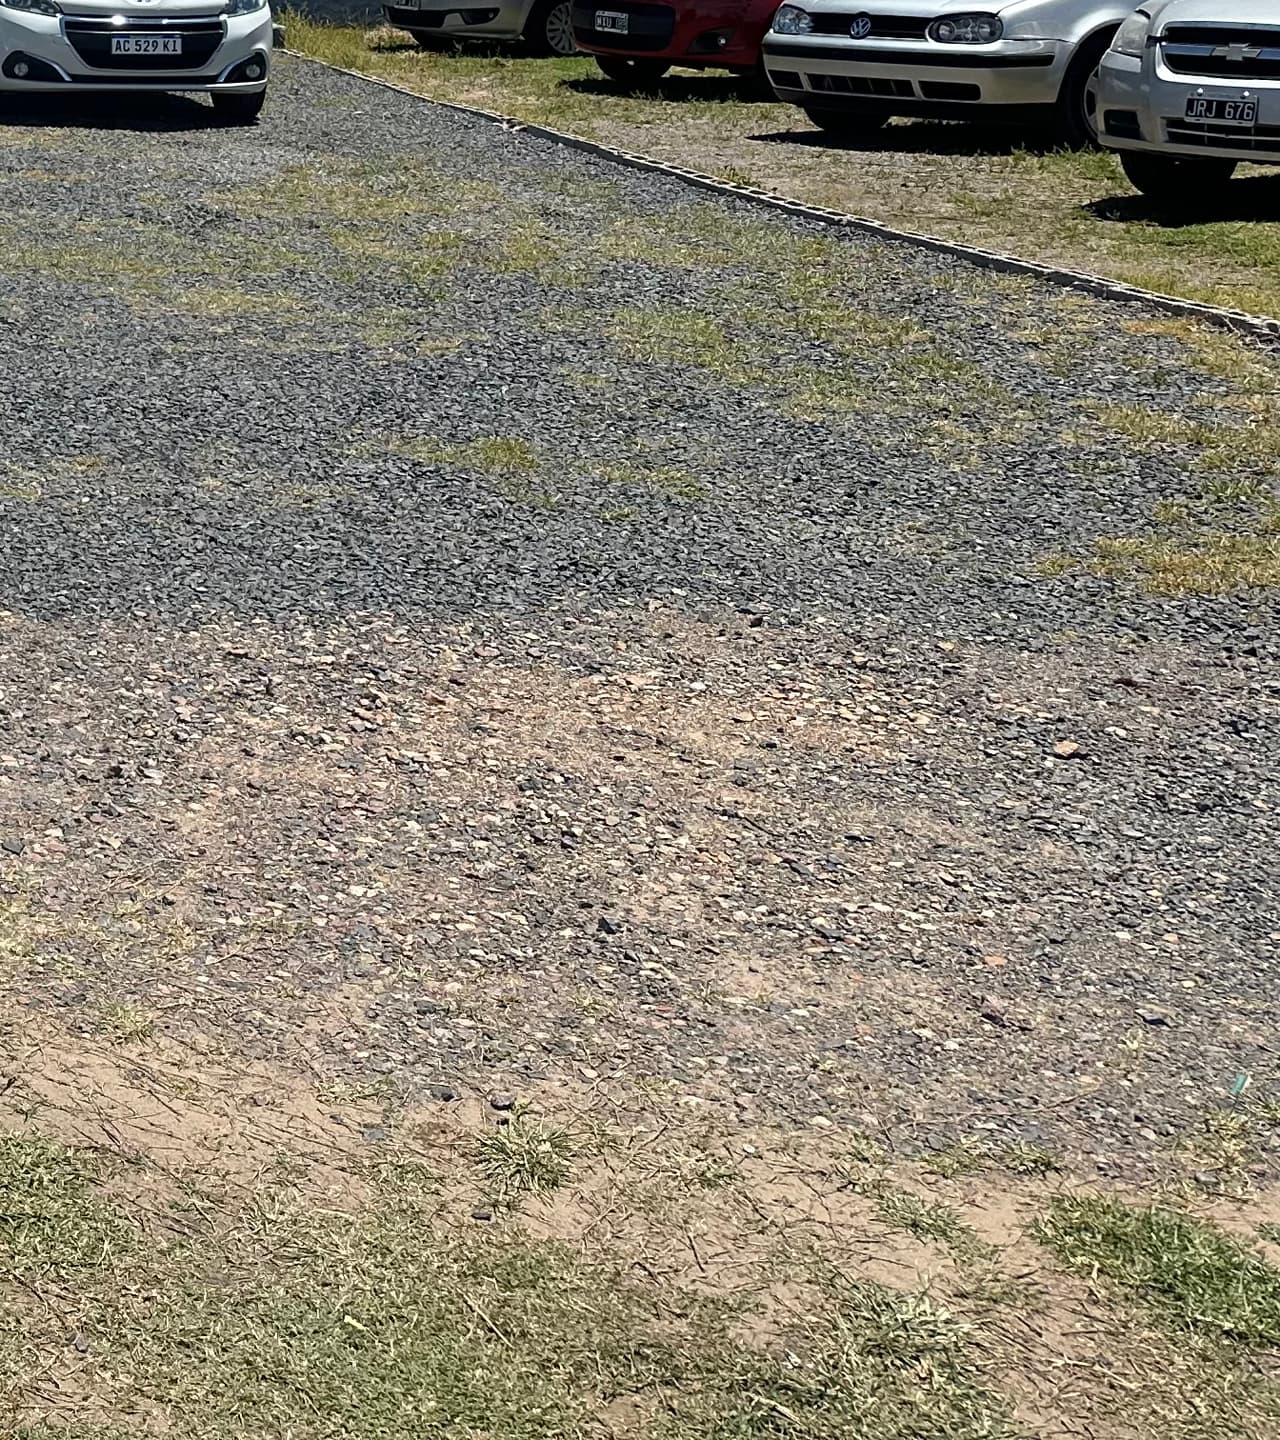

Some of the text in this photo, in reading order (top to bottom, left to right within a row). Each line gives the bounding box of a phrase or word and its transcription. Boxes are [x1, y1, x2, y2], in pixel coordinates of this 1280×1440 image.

[115, 39, 178, 52] AC 529 KI
[1187, 100, 1254, 120] JRJ 676
